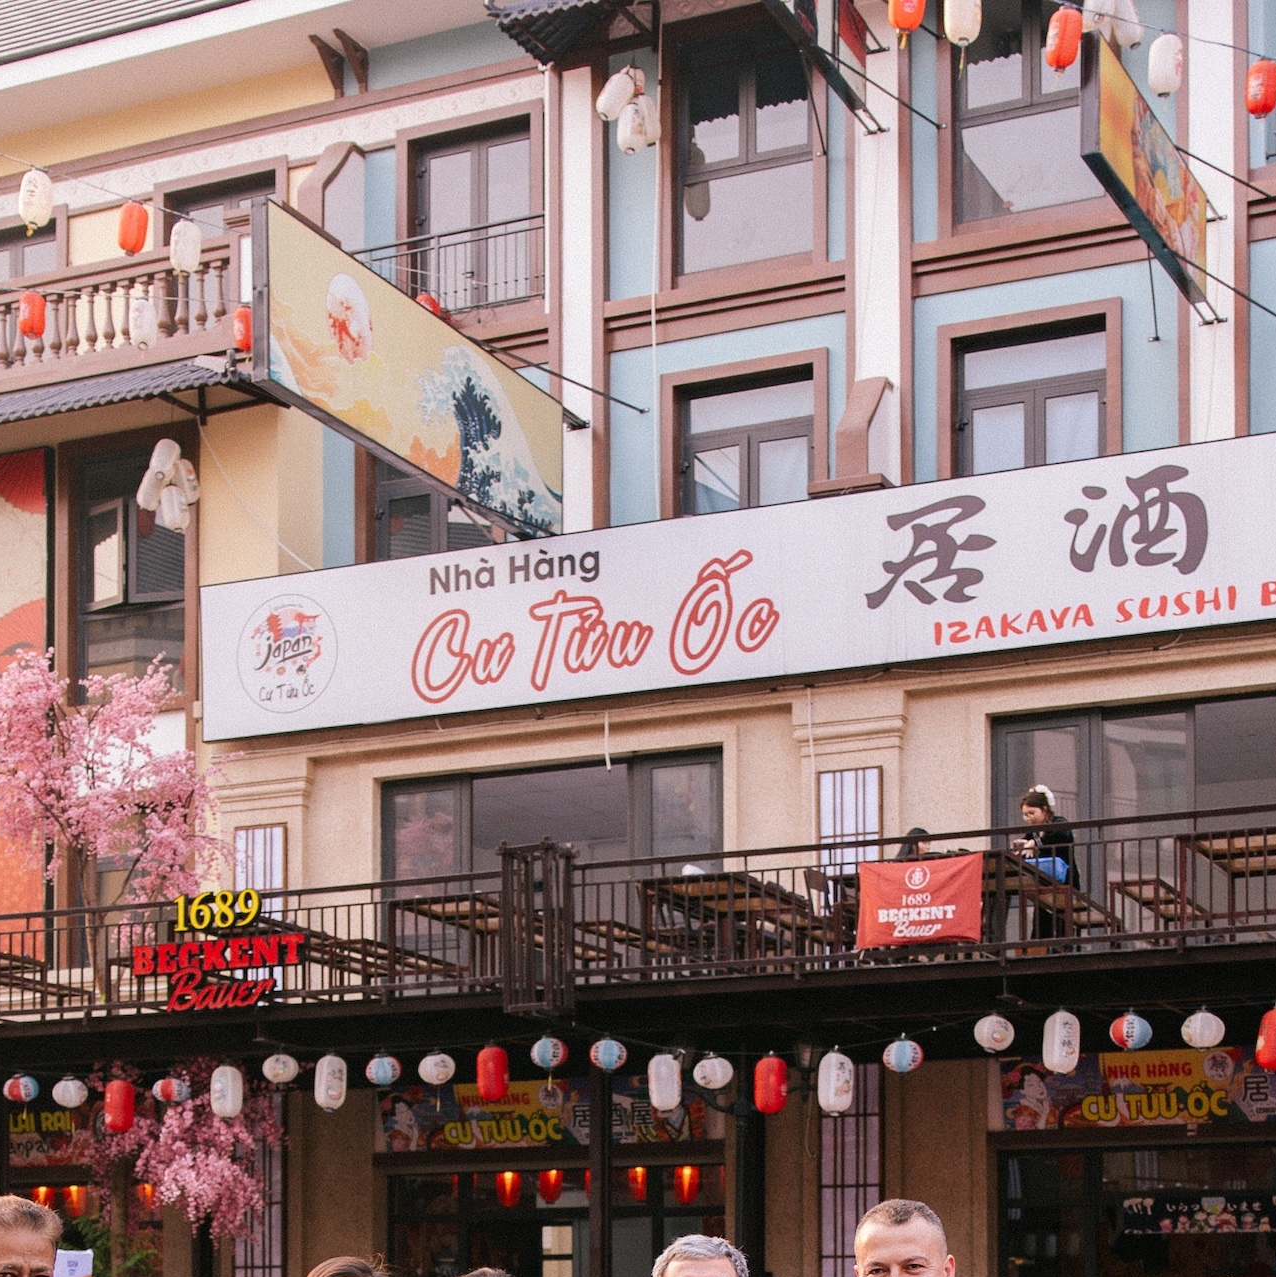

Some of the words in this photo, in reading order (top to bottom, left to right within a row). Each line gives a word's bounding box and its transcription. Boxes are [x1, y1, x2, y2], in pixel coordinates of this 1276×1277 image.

[430, 557, 496, 595] Nhà
[510, 549, 600, 588] Hàng
[1115, 589, 1237, 624] SUSHI
[411, 608, 514, 703] Cu
[670, 549, 780, 675] Ốc
[174, 888, 260, 932] 1689
[877, 905, 956, 923] BECKENT
[902, 893, 931, 906] 1689
[893, 919, 942, 938] Bauer
[132, 934, 305, 975] BECKENT
[167, 967, 274, 1013] Bauer
[1082, 1093, 1117, 1121] CU
[444, 1122, 471, 1144] CU
